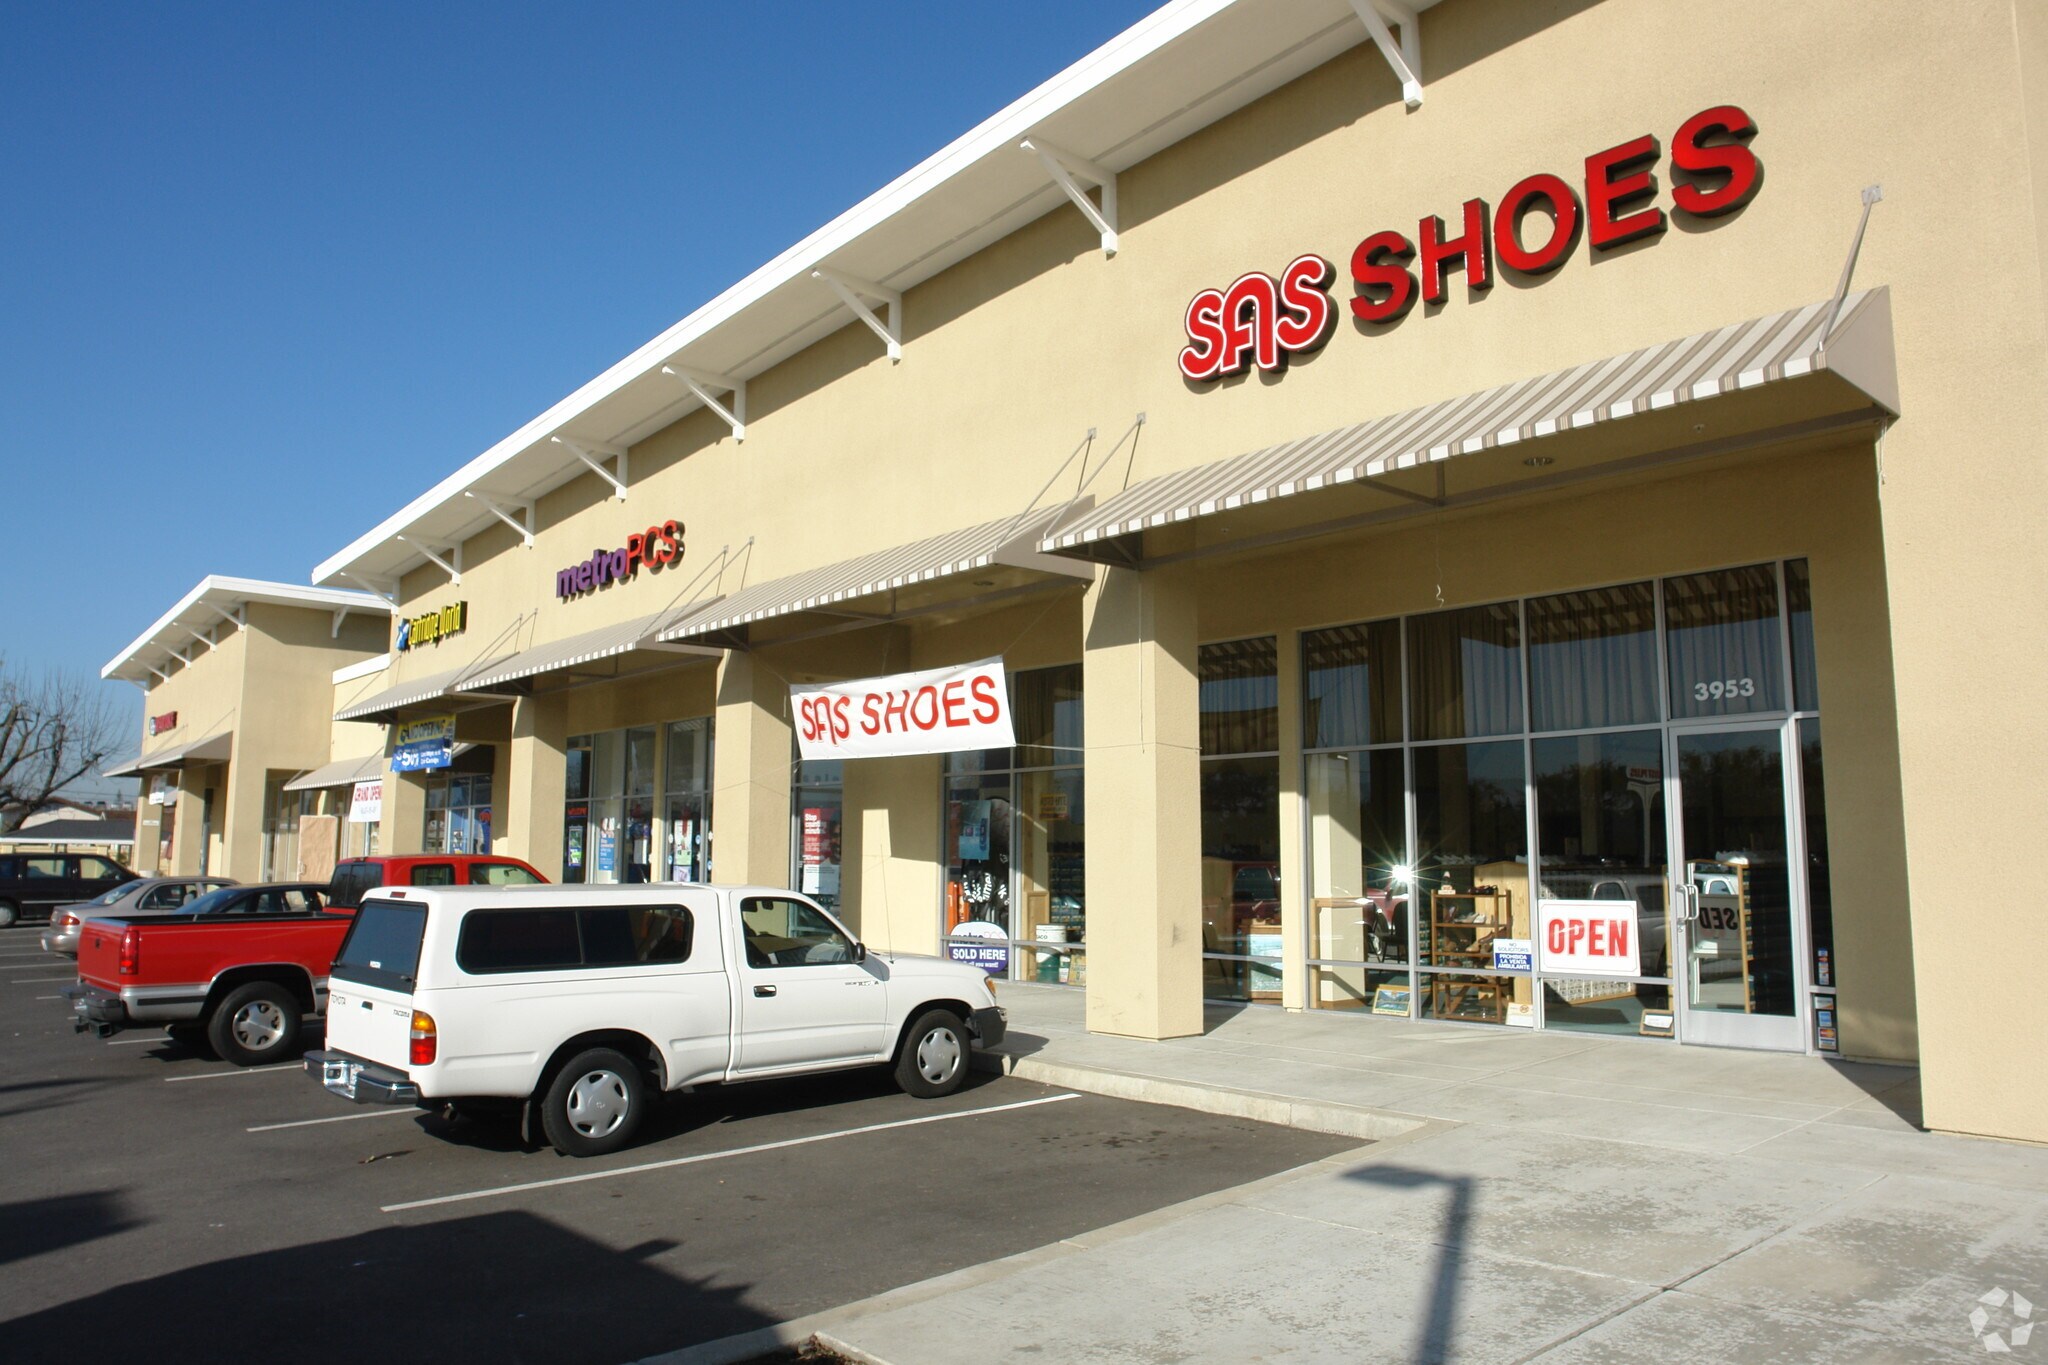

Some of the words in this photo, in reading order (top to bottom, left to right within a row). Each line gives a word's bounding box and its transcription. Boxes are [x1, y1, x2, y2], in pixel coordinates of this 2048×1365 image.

[1178, 254, 1331, 379] SAS
[1350, 105, 1759, 322] SHOES
[556, 519, 680, 599] metroPCS
[439, 601, 462, 636] World
[1694, 678, 1755, 701] 3953
[801, 694, 851, 746] SAS
[860, 675, 1000, 736] SHOES
[952, 948, 977, 960] SOLD
[979, 948, 1006, 961] HERE
[1547, 918, 1629, 957] OPEN
